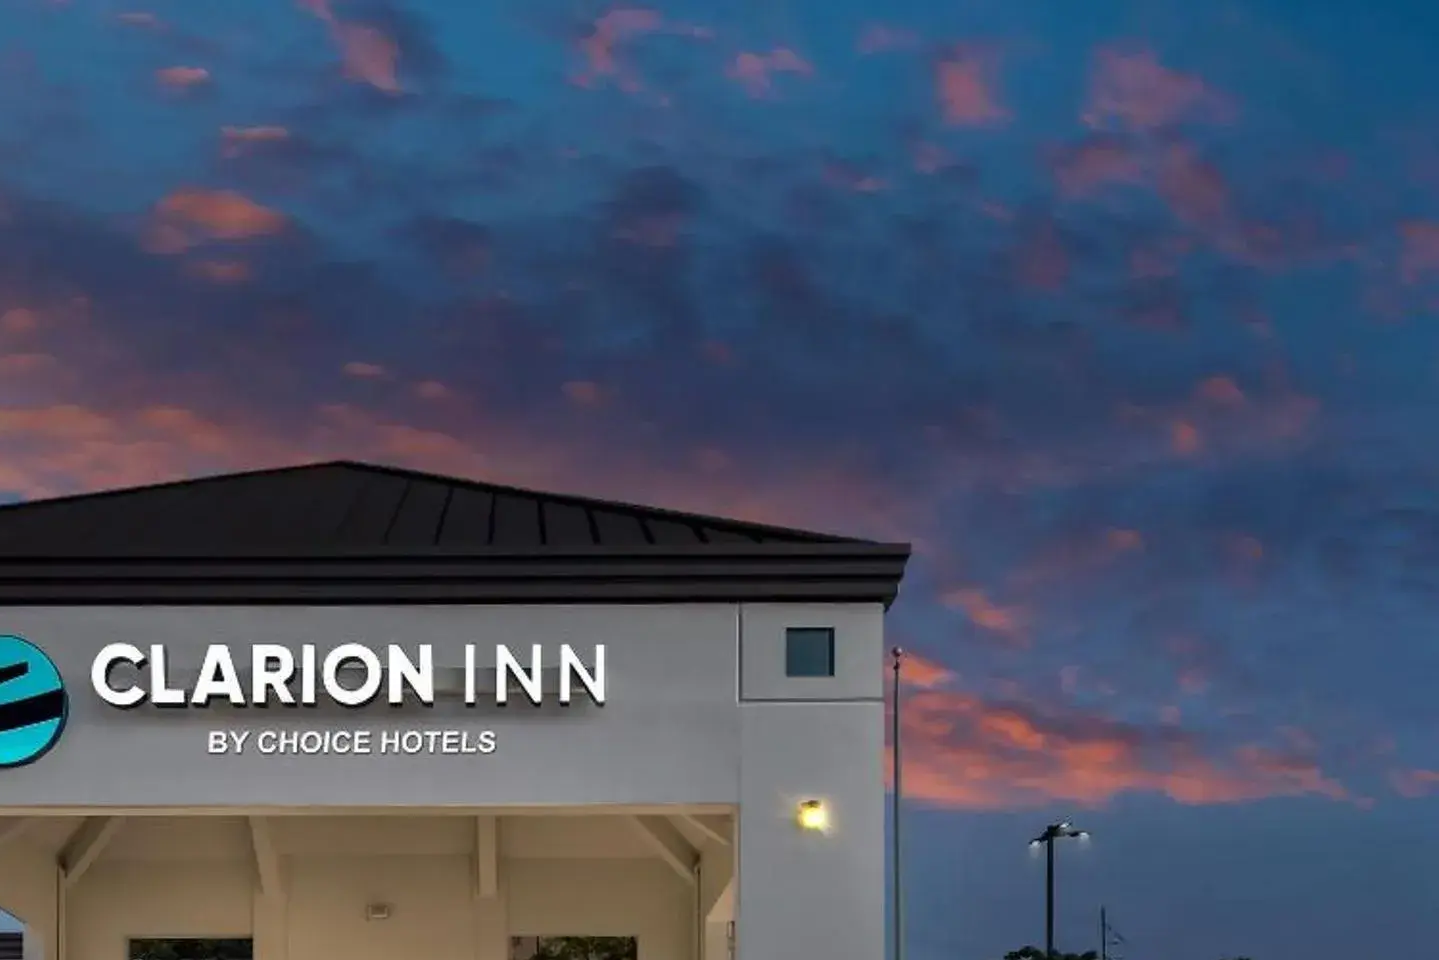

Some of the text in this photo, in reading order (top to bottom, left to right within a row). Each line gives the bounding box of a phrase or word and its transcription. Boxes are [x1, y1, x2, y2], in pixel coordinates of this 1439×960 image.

[90, 643, 607, 706] CLARION INN
[207, 730, 497, 754] BY CHOICE HOTELS
